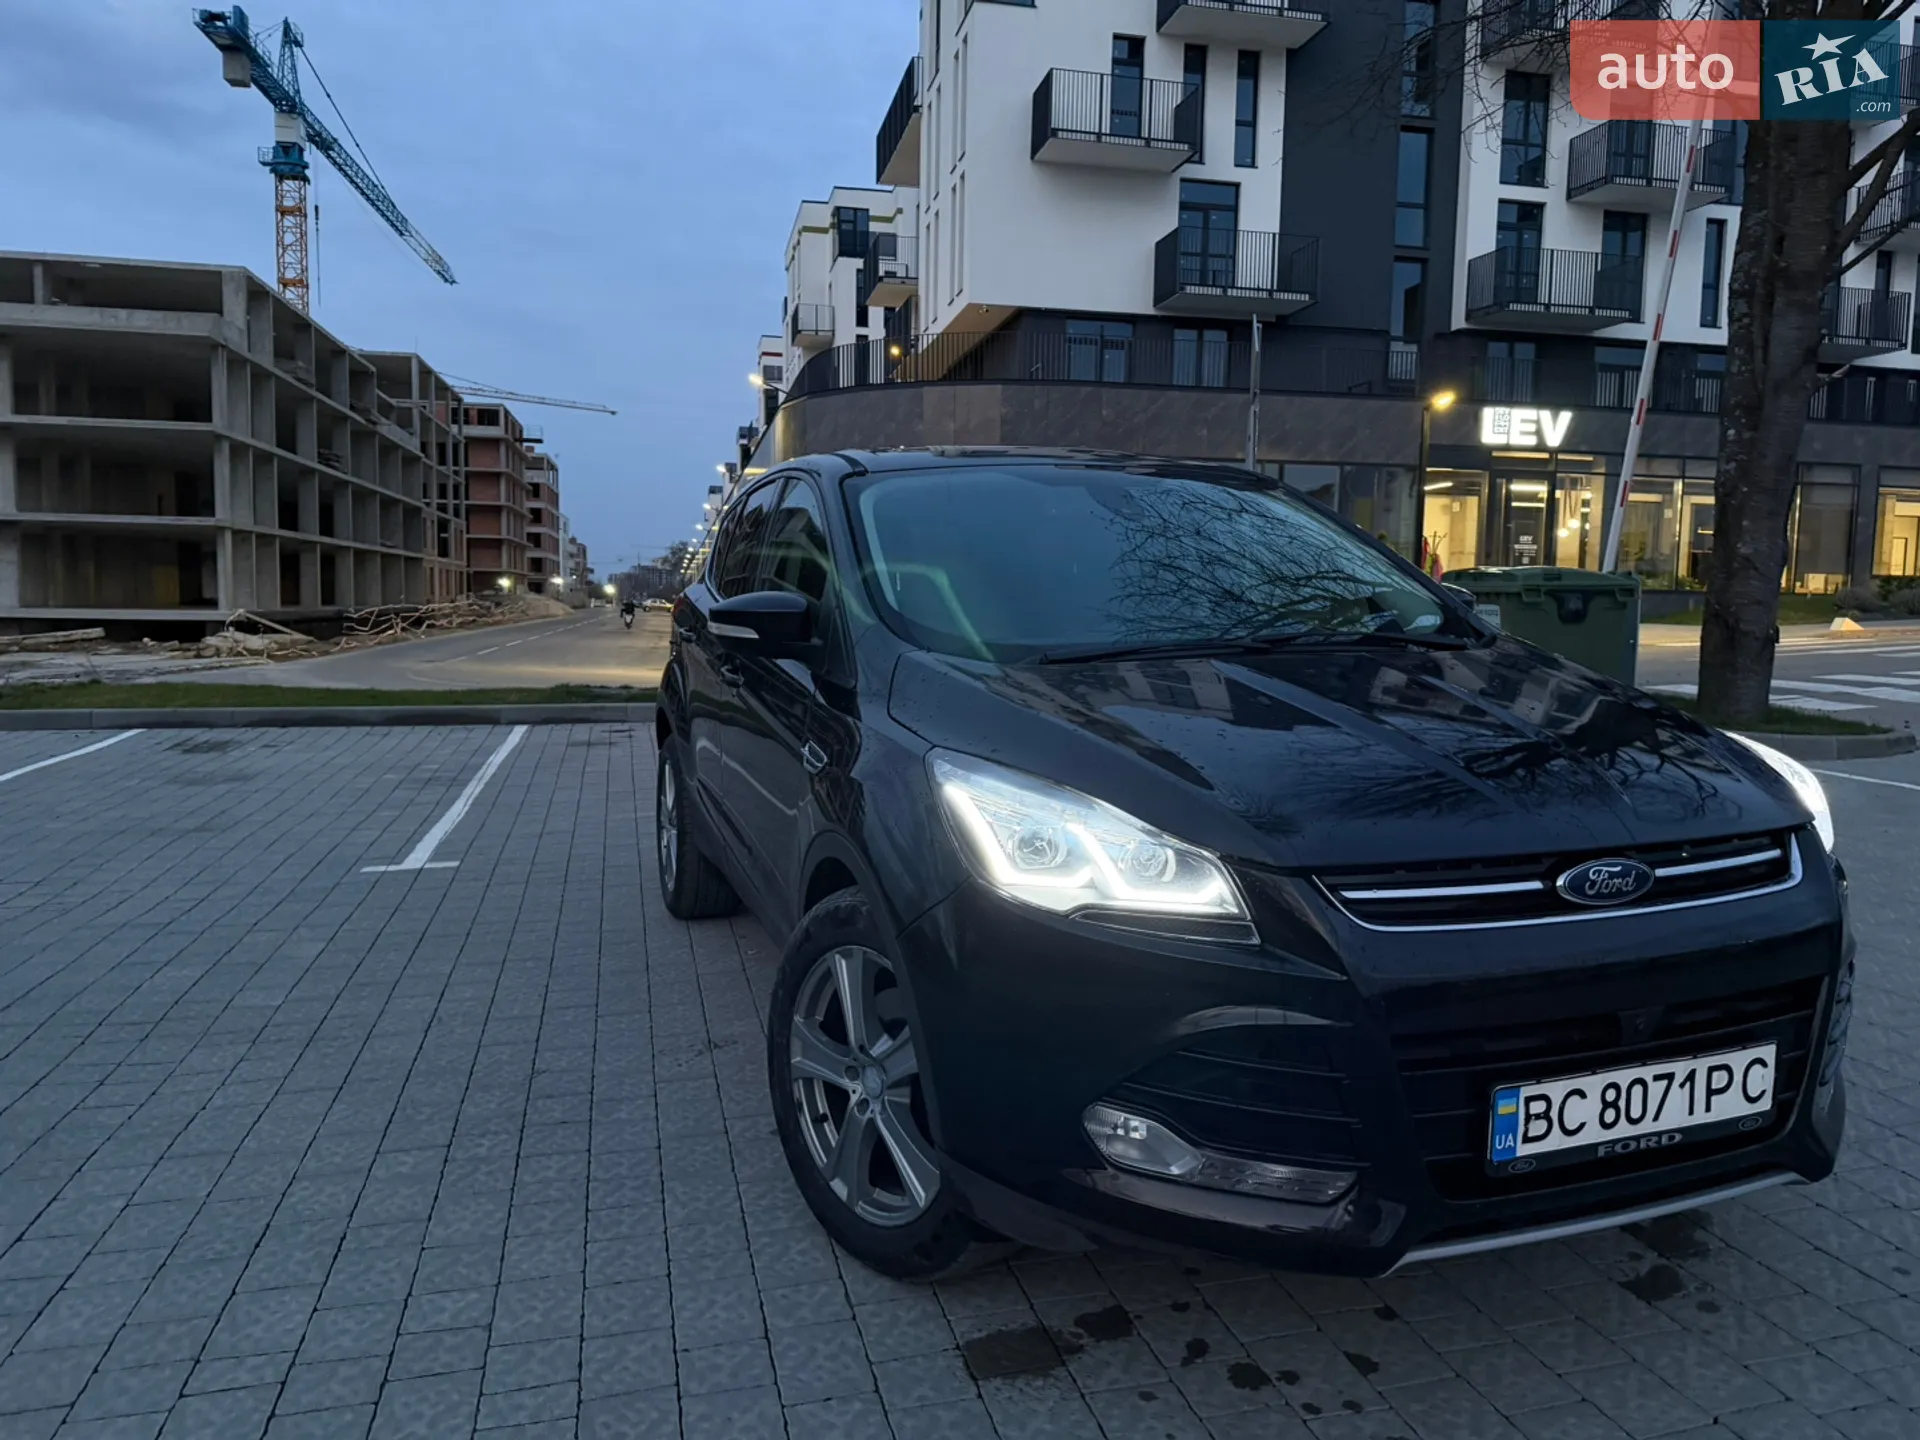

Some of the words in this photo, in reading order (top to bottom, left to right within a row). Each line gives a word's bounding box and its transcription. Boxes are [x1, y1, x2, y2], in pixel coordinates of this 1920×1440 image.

[1481, 406, 1573, 447] LEV
[1585, 865, 1637, 896] Ford
[1495, 1132, 1515, 1149] UA
[1597, 1131, 1683, 1158] FORD
